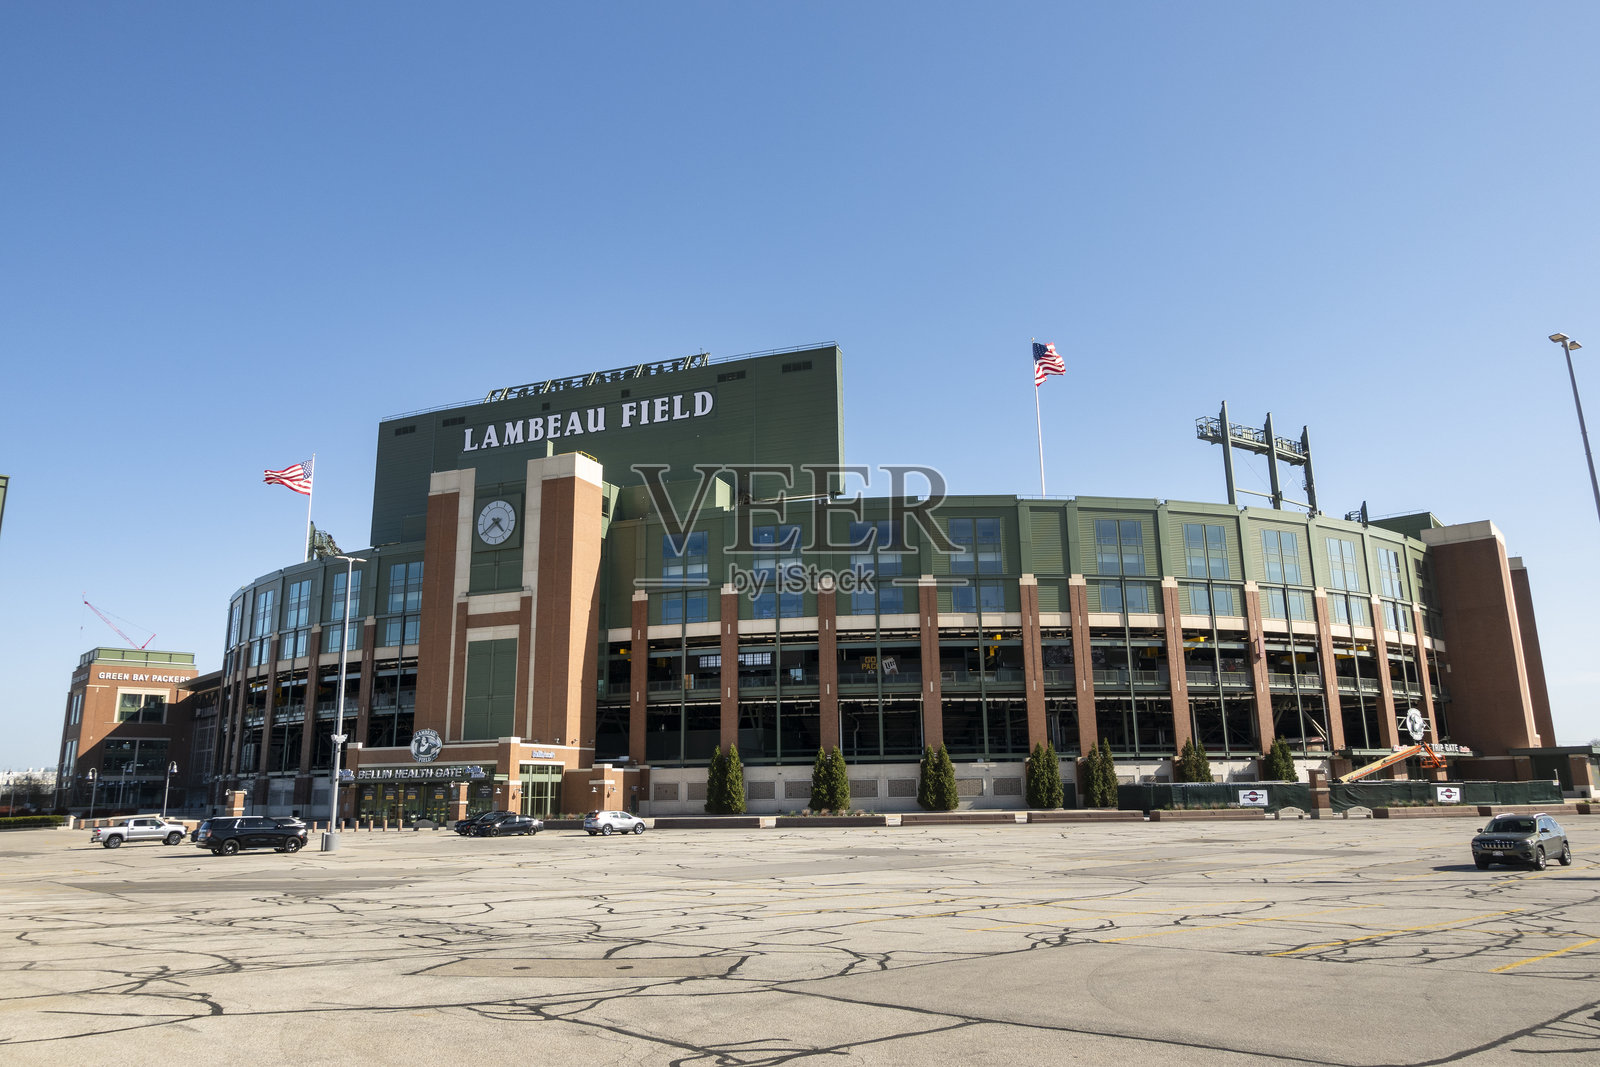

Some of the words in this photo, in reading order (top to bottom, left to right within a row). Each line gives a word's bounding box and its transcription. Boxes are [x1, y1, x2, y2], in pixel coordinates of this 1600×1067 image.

[462, 407, 607, 453] LAMBEAU
[620, 390, 714, 428] FIELD
[98, 671, 130, 681] GREEN
[132, 673, 150, 682] BAY
[1445, 743, 1459, 752] GATE
[358, 769, 393, 779] BELLIN
[395, 768, 434, 778] HEALTH
[434, 767, 463, 778] GATE
